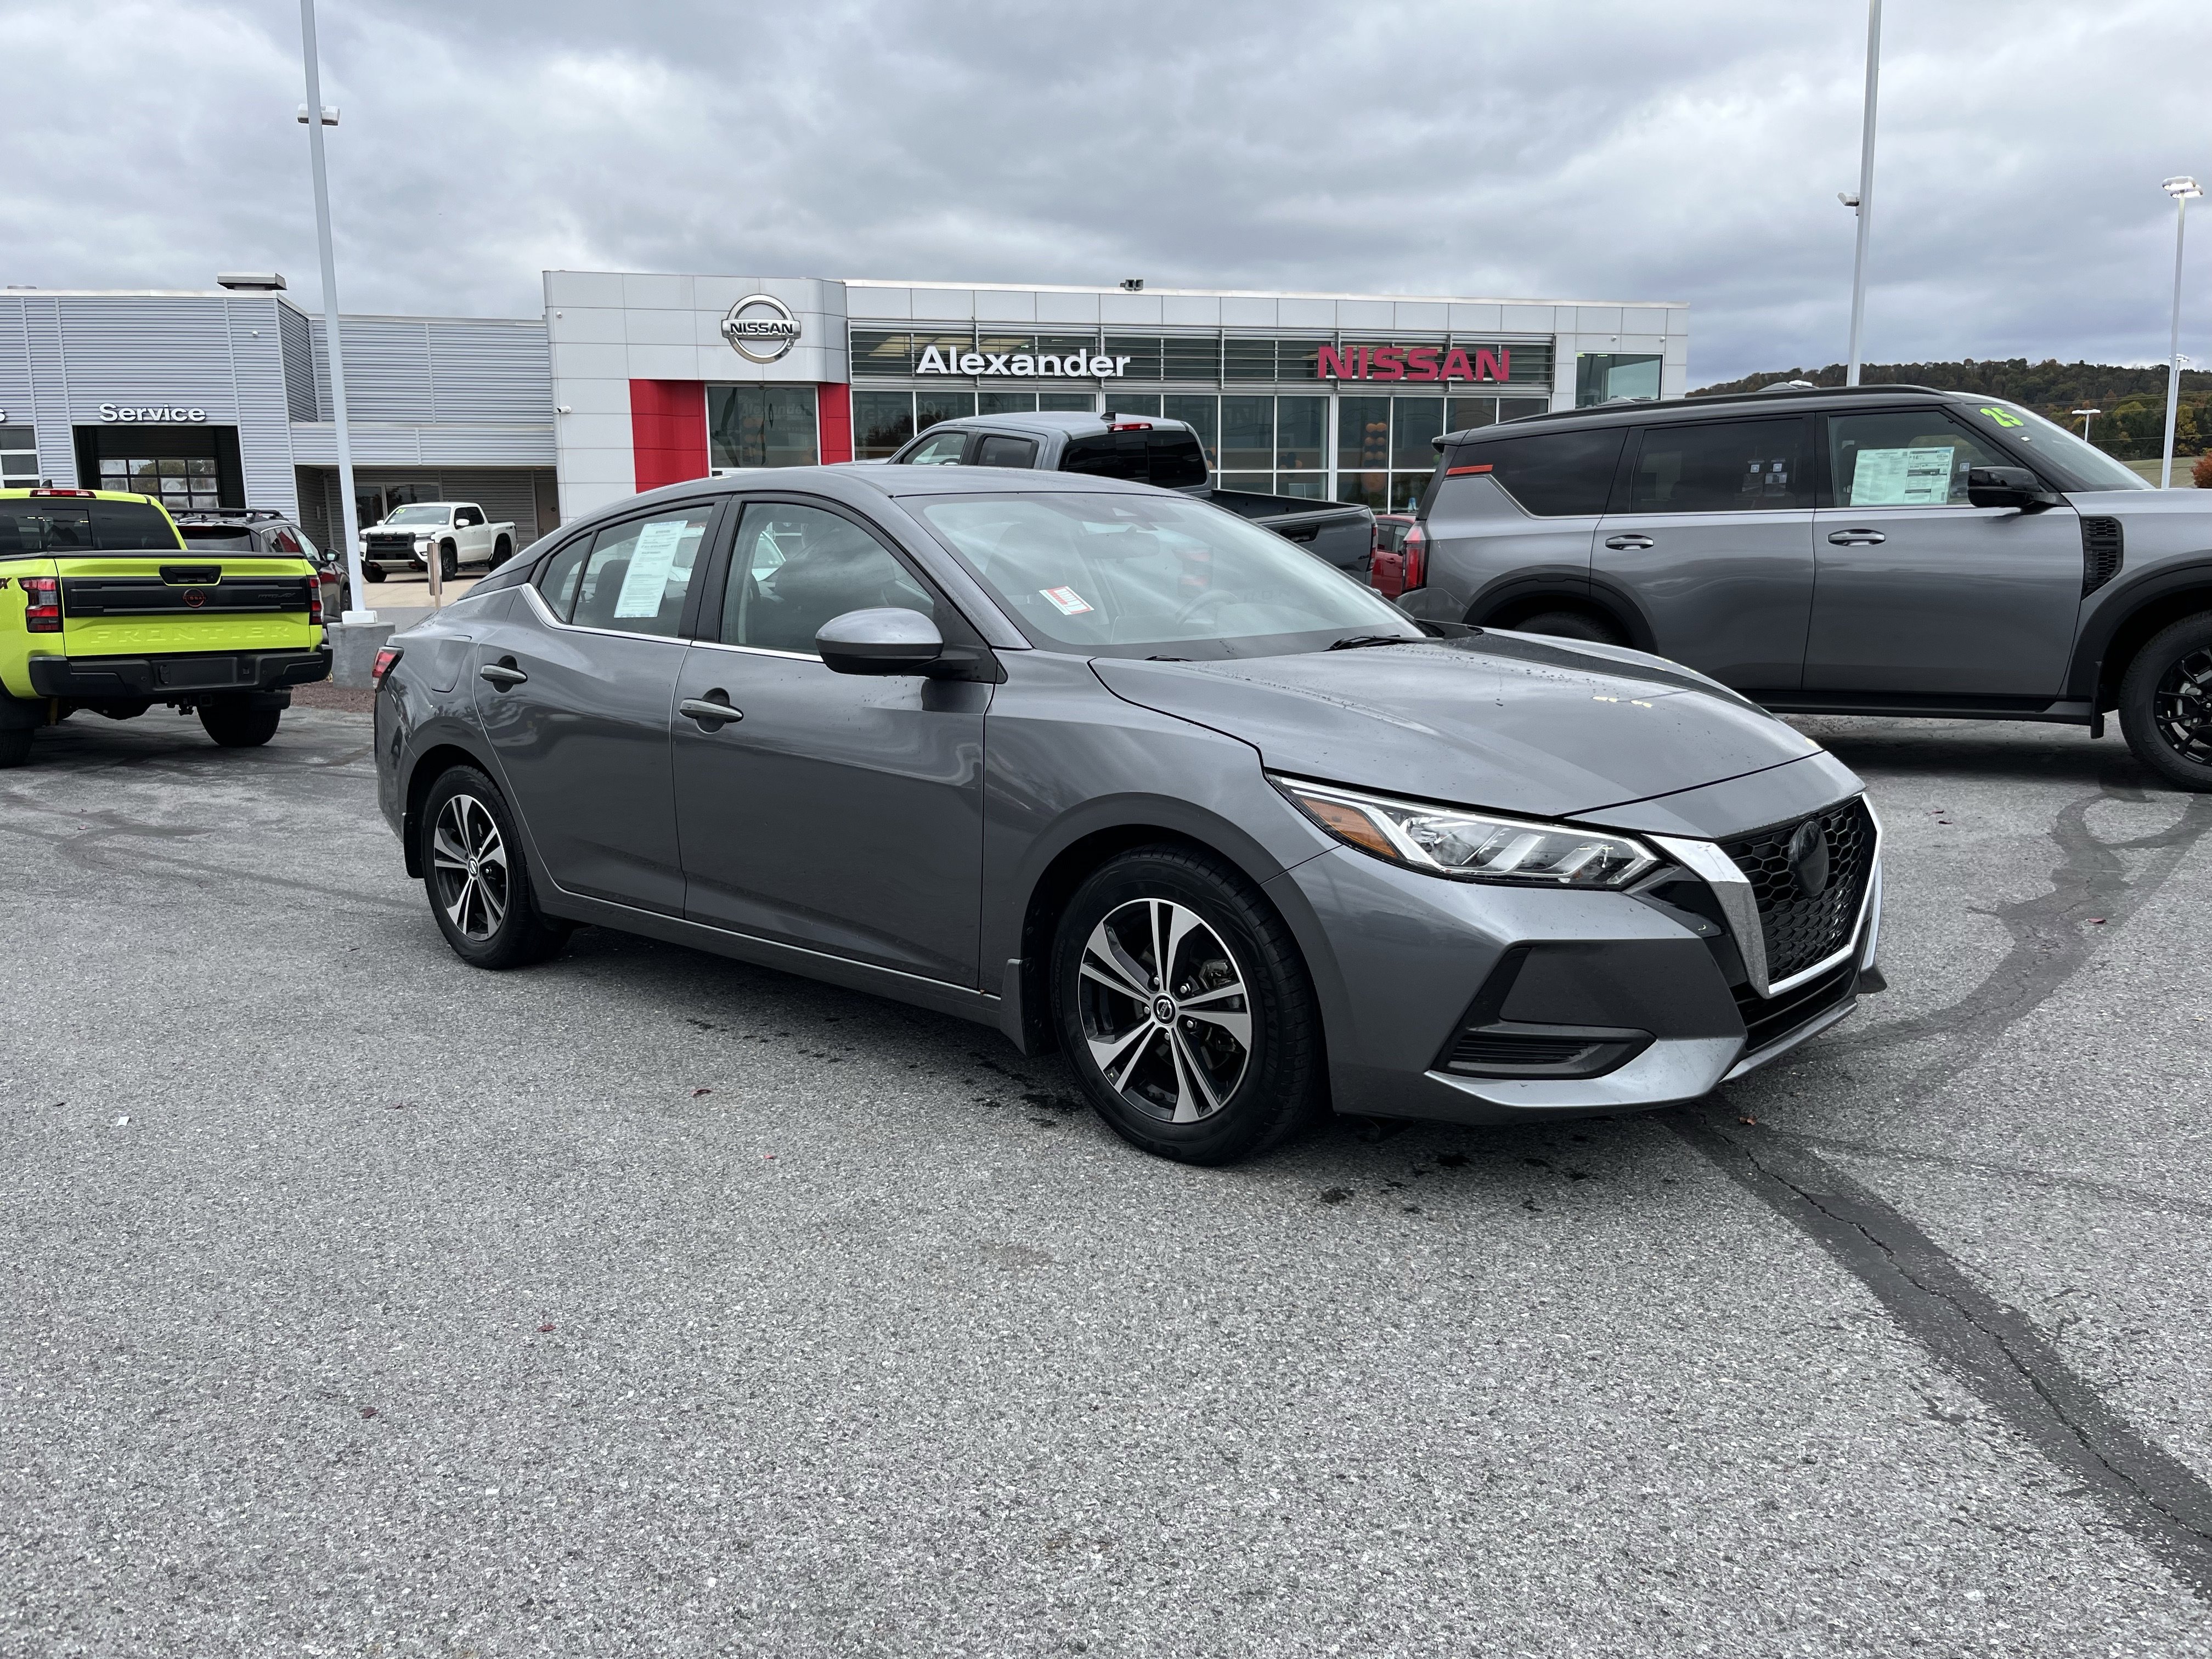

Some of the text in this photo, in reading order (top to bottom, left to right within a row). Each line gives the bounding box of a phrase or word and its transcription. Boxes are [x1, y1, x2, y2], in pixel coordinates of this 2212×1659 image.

[730, 322, 794, 336] NISSAN
[916, 346, 1131, 377] Alexander
[1318, 346, 1510, 382] NISSAN
[98, 403, 206, 422] Service
[1979, 407, 2024, 428] 25
[89, 625, 291, 644] FRONTIER
